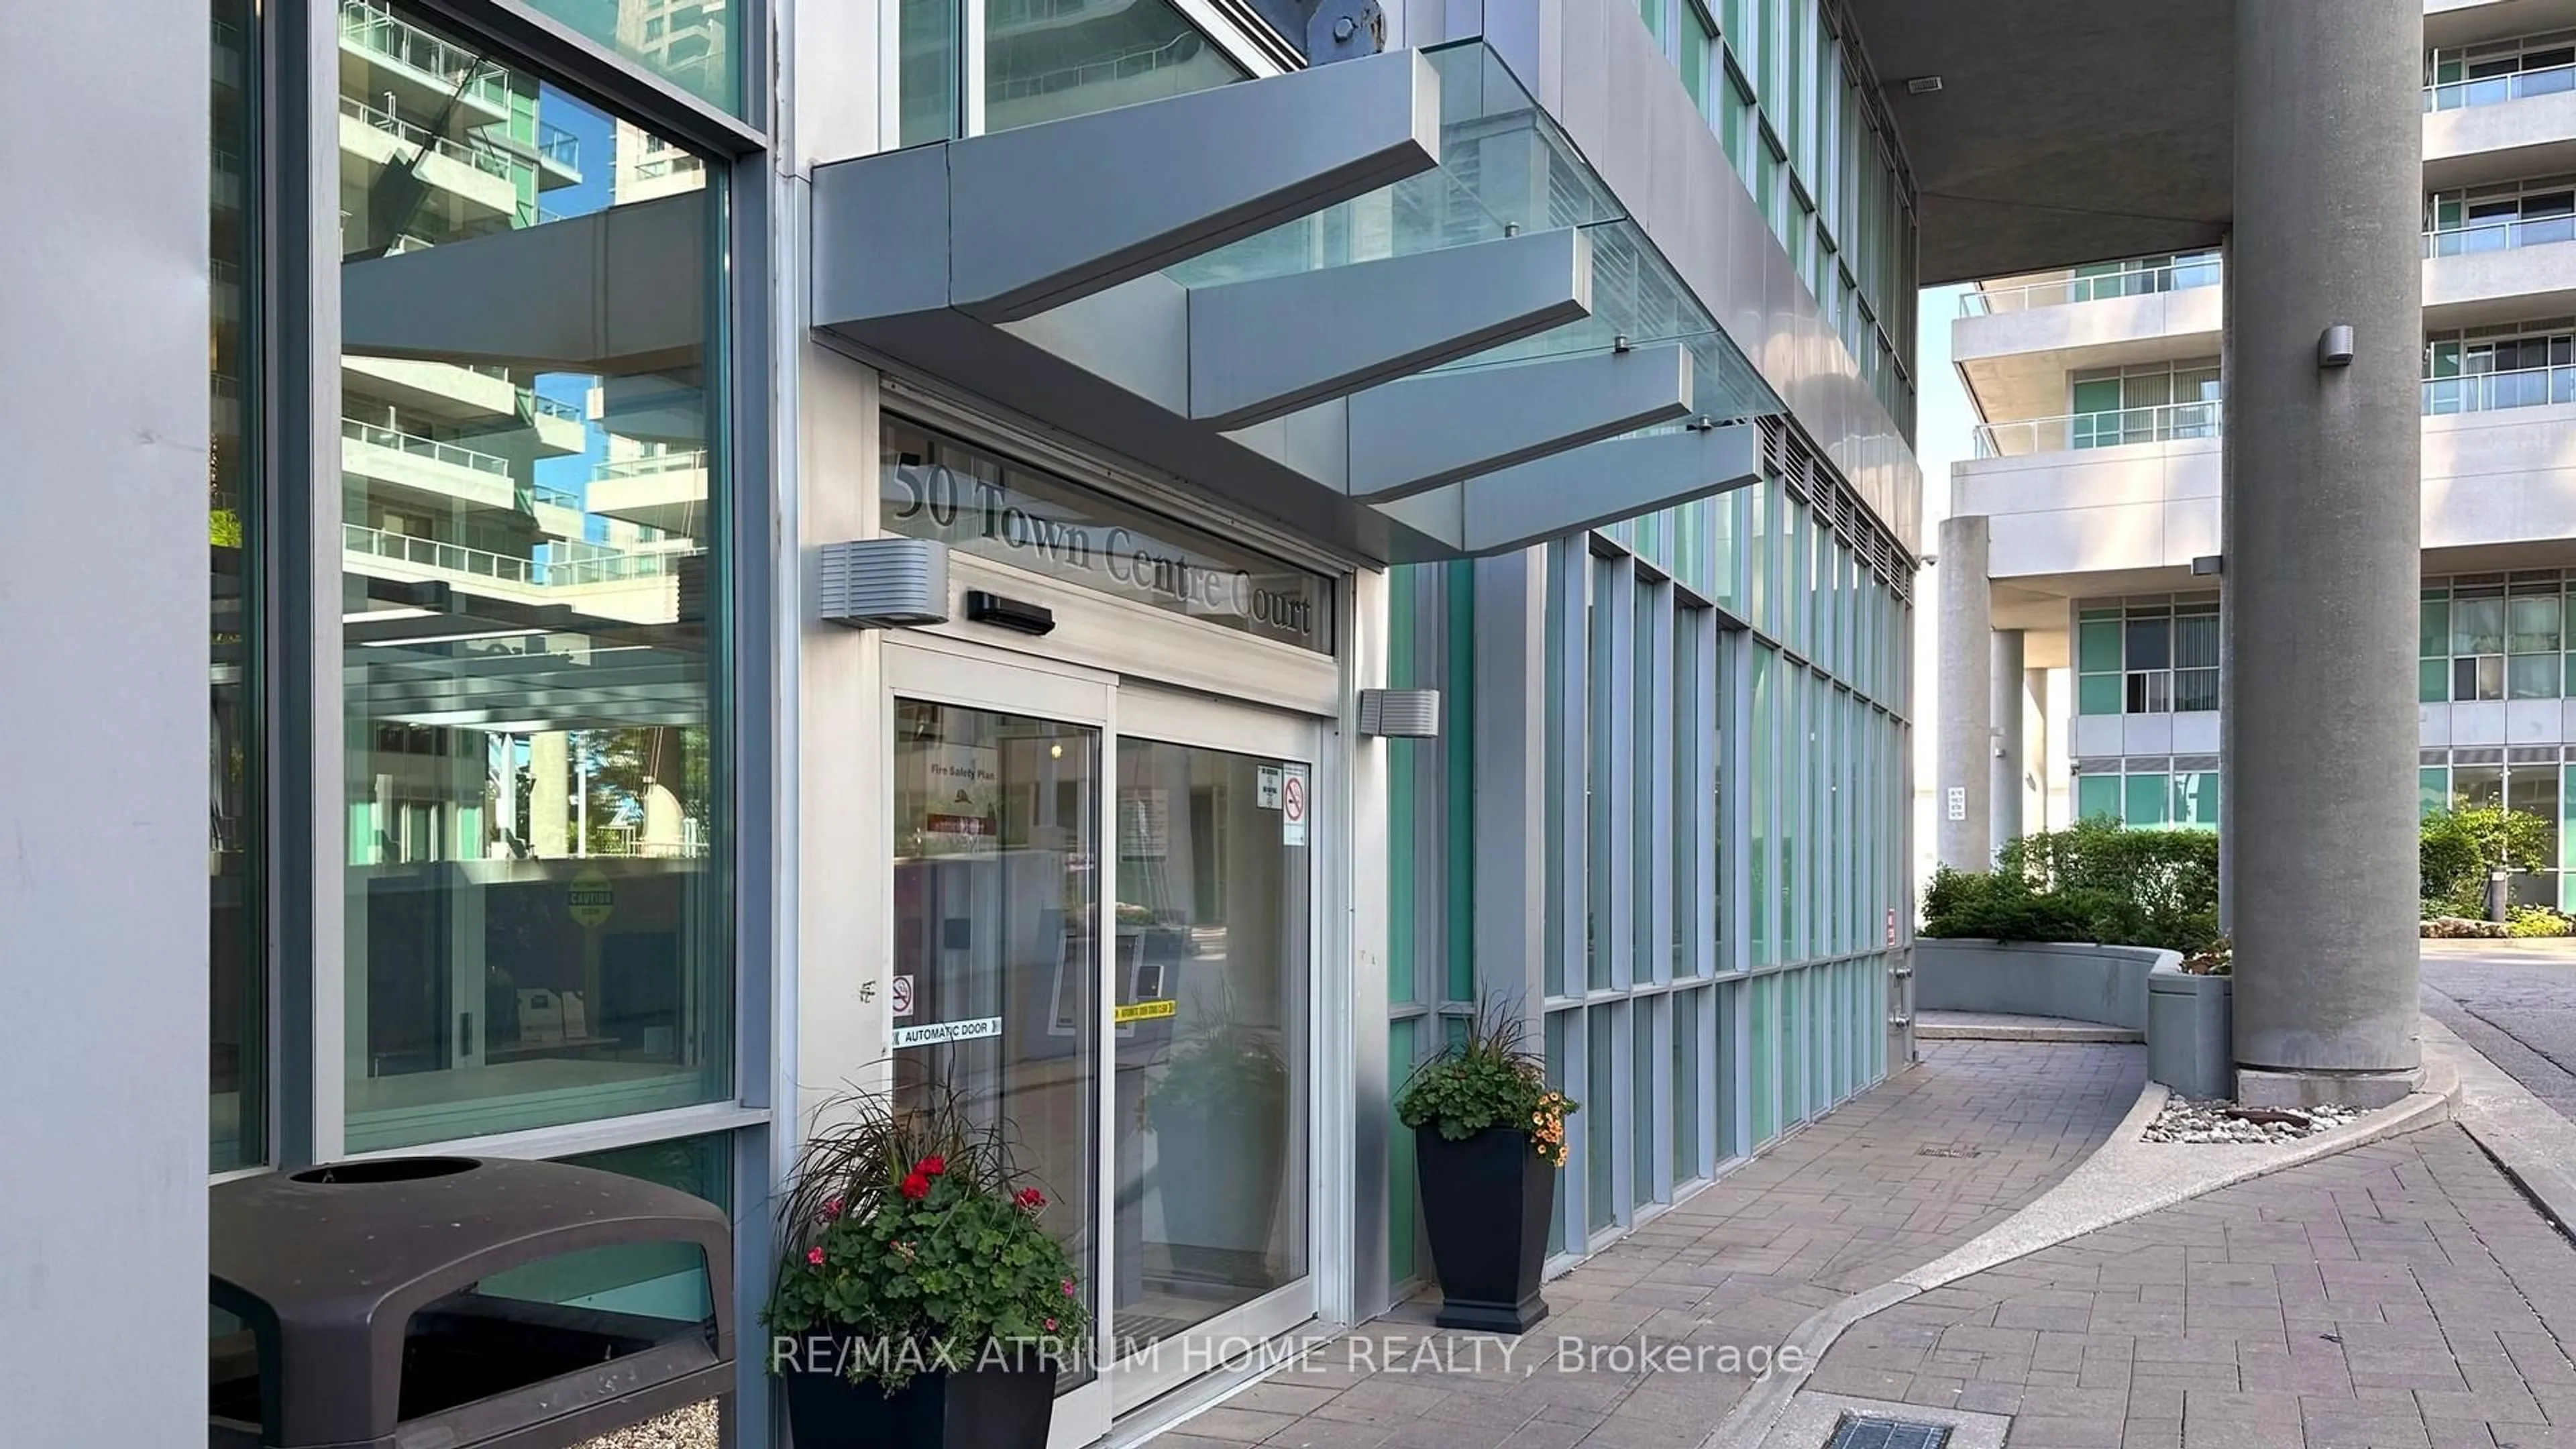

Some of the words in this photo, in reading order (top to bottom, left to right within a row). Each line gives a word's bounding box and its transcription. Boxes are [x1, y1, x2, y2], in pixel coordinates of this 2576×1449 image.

[893, 453, 958, 527] 50
[975, 482, 1091, 570] Town
[1106, 527, 1220, 609] Centre
[1231, 570, 1311, 635] Court
[931, 763, 948, 775] Fire
[962, 1022, 987, 1035] DOOR
